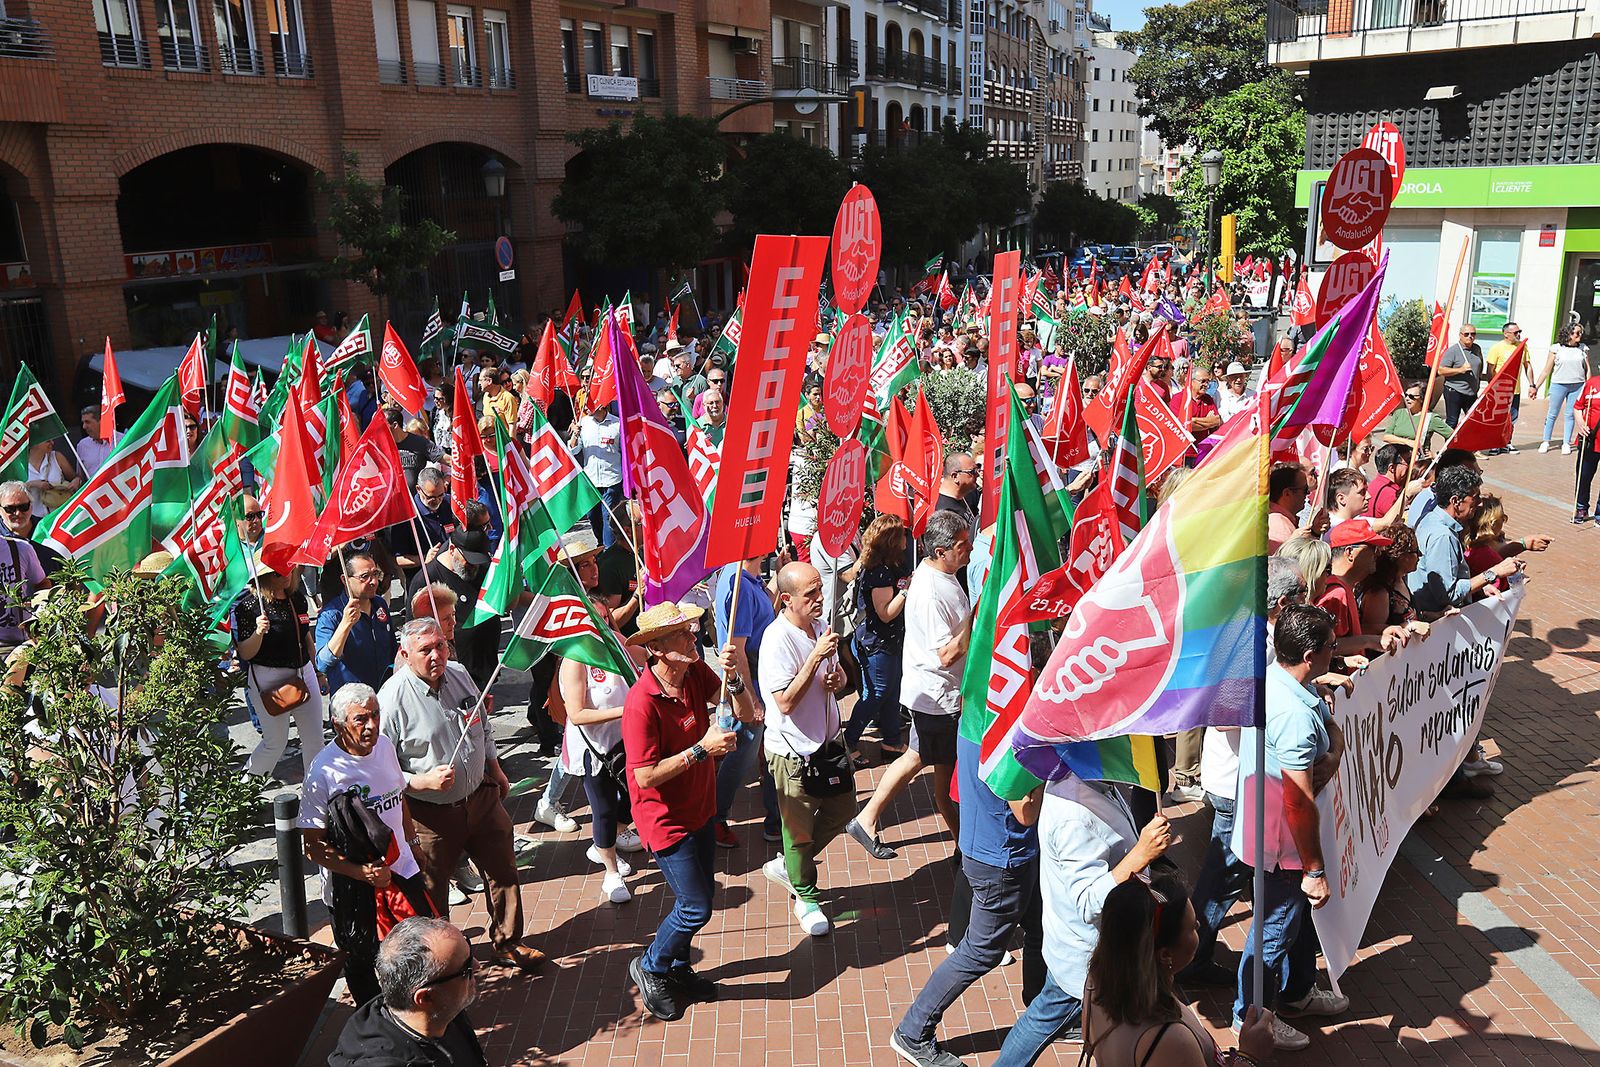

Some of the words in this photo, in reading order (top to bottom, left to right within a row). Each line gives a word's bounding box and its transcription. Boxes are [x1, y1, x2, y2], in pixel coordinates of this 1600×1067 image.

[1333, 160, 1385, 199] UGT
[1495, 184, 1533, 193] CLIENTE
[841, 198, 874, 252] UGT
[1335, 225, 1373, 240] Andalucía
[1326, 262, 1372, 300] UGT
[746, 266, 804, 460] CCOO
[832, 323, 869, 380] UGT
[1140, 394, 1187, 443] www.UGT.e
[826, 446, 862, 506] UGT
[734, 515, 761, 528] HUELVA
[1388, 663, 1424, 723] Subir
[1420, 678, 1486, 756] repartir
